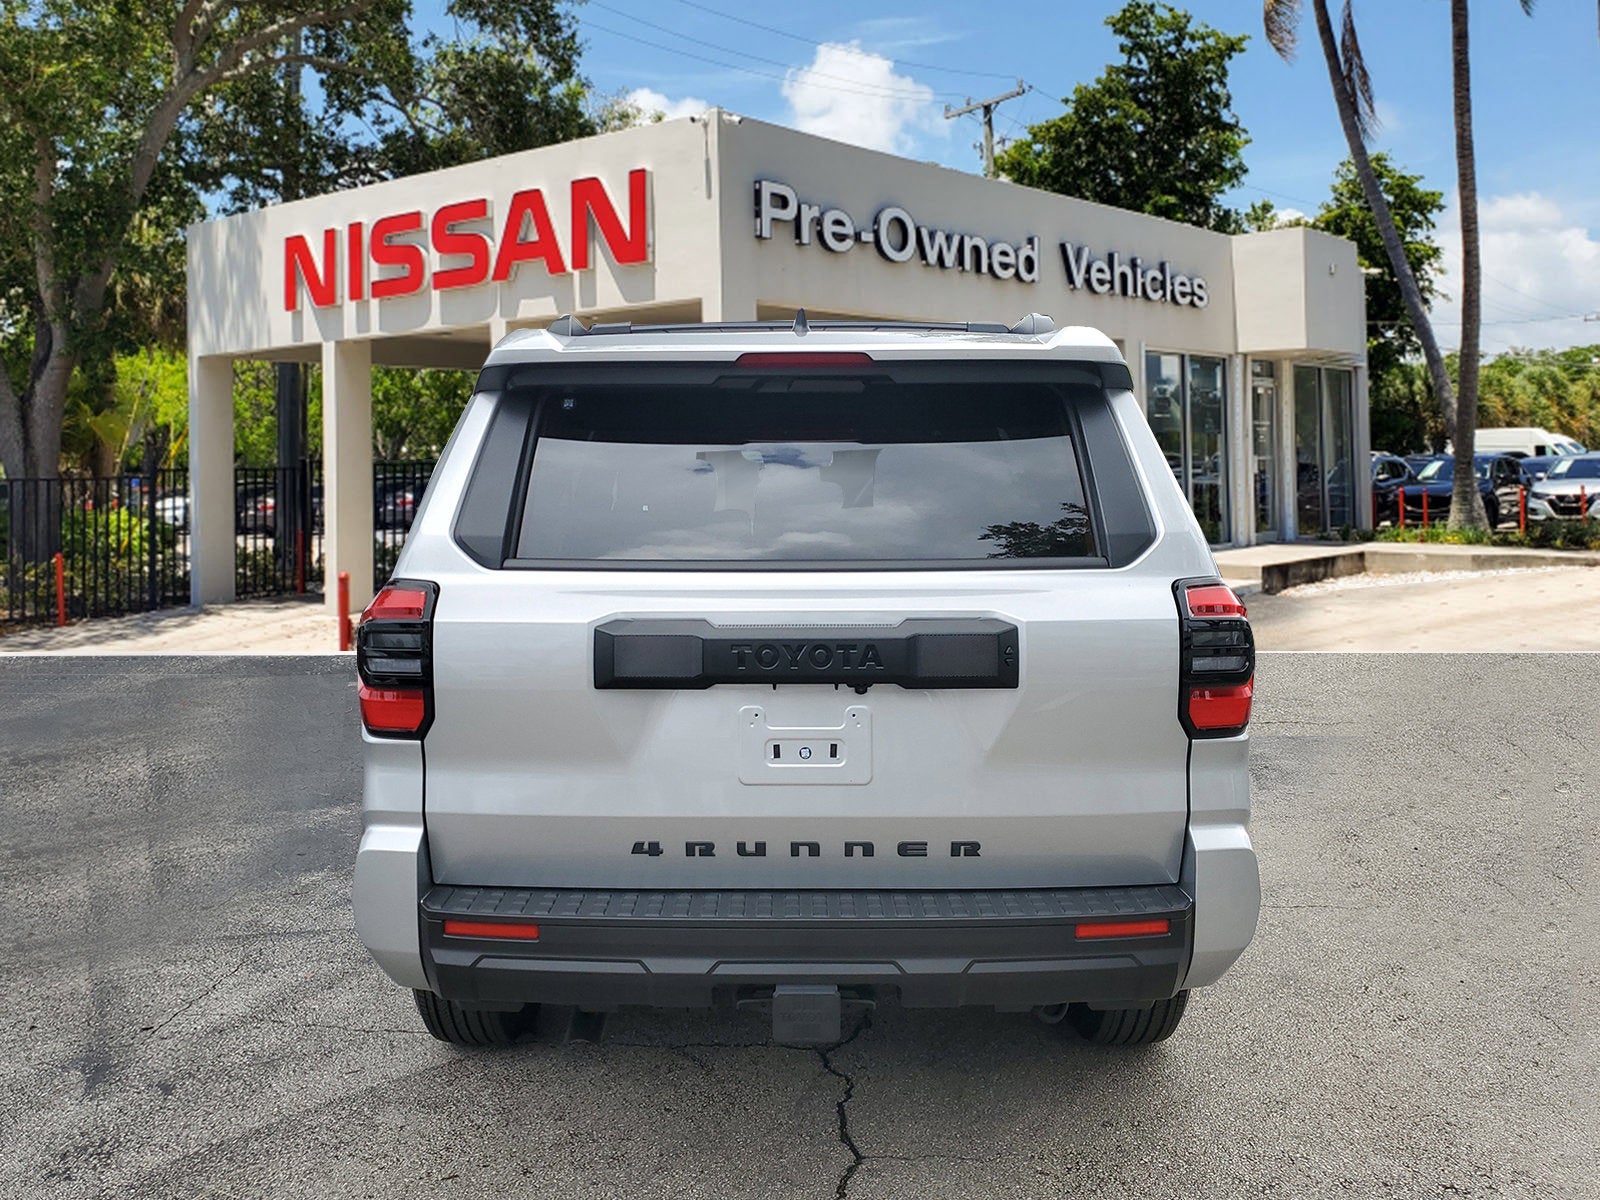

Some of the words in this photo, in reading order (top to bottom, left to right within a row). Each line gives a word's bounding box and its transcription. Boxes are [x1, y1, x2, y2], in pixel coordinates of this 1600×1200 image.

[284, 168, 648, 312] NISSAN
[755, 180, 1040, 283] Pre-Owned
[1060, 241, 1209, 308] Vehicles
[731, 644, 884, 670] TOYOTA
[631, 841, 982, 857] 4RUNNER
